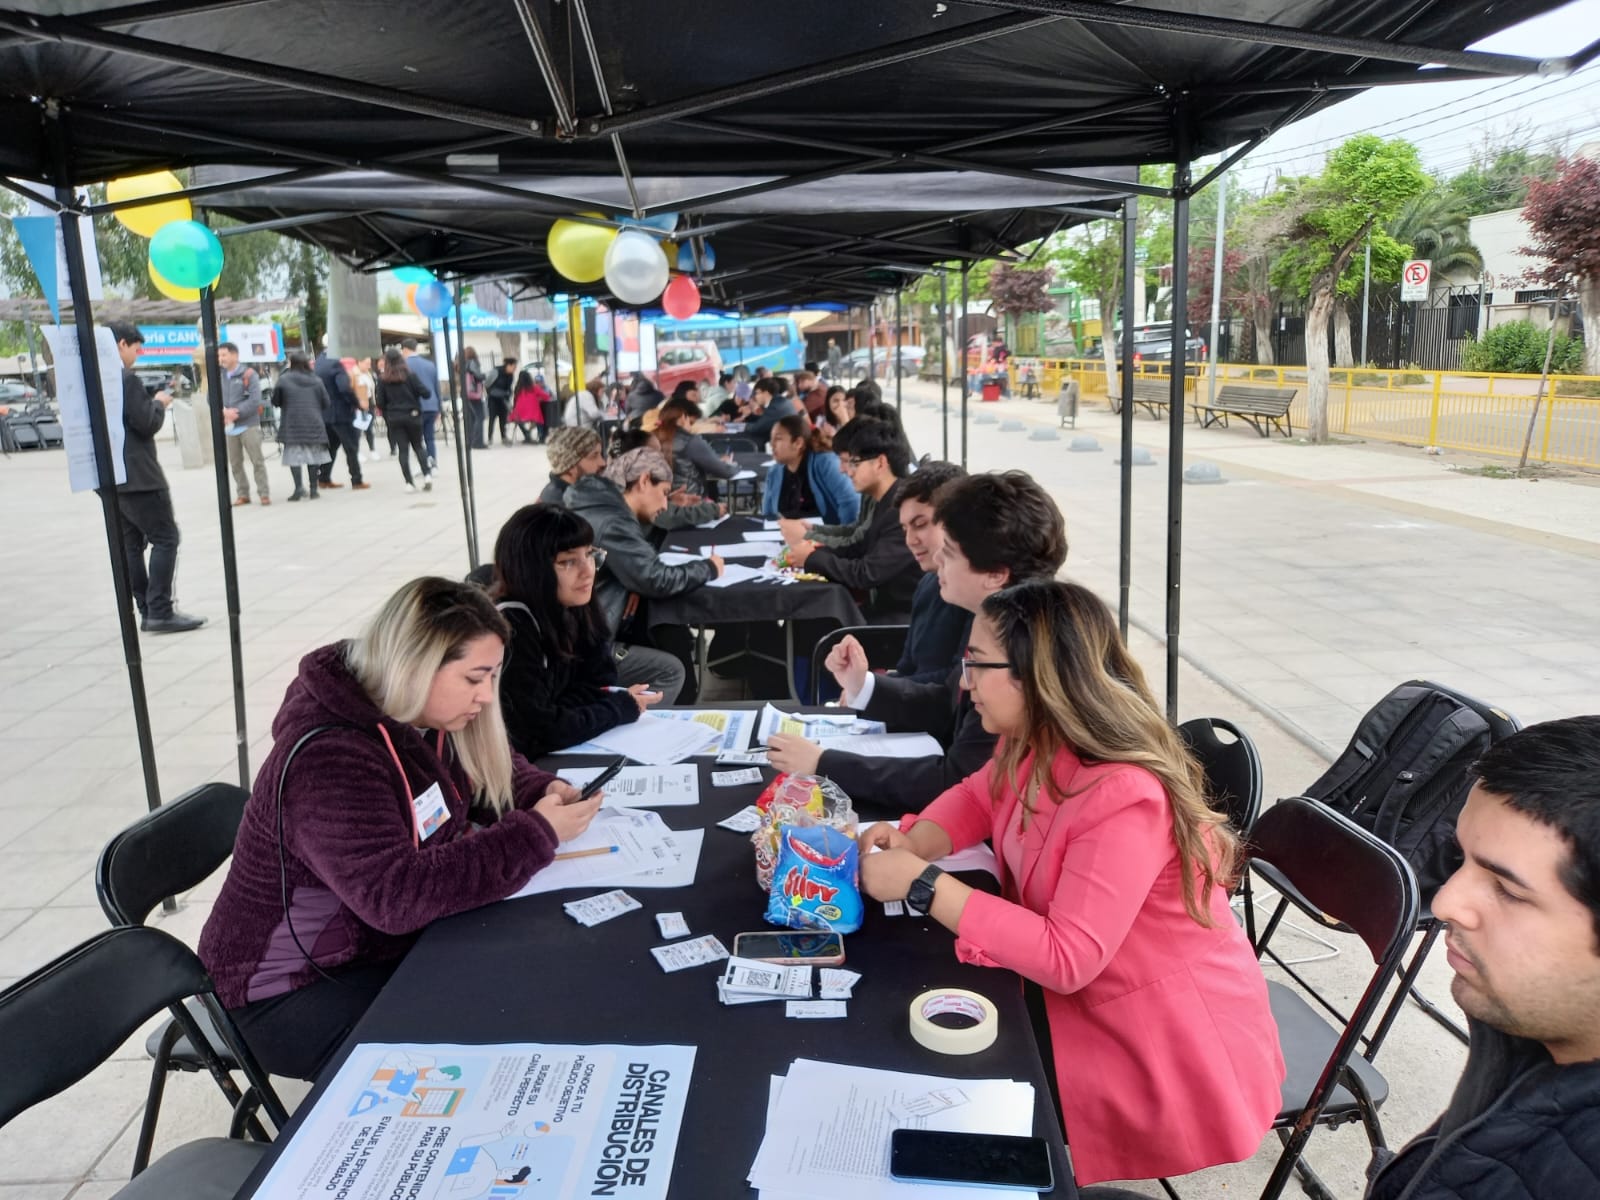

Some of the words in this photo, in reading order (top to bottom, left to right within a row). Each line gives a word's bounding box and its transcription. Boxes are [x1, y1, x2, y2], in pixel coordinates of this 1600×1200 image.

[525, 1053, 541, 1081] CANAL
[527, 1064, 550, 1094] BUSQUE
[579, 1063, 595, 1095] CONOCE
[507, 1080, 532, 1116] PERFECTO
[526, 1093, 538, 1106] SU
[553, 1086, 574, 1123] OBJETIVO
[571, 1101, 583, 1113] TU
[630, 1070, 670, 1154] CANALES
[351, 1137, 365, 1150] SU
[358, 1126, 372, 1138] DE
[417, 1126, 437, 1149] PARA
[432, 1126, 451, 1149] CREE
[410, 1149, 425, 1162] SU
[325, 1150, 358, 1191] TRABAJO
[334, 1157, 367, 1200] EFICIENCI
[621, 1158, 650, 1187] DE
